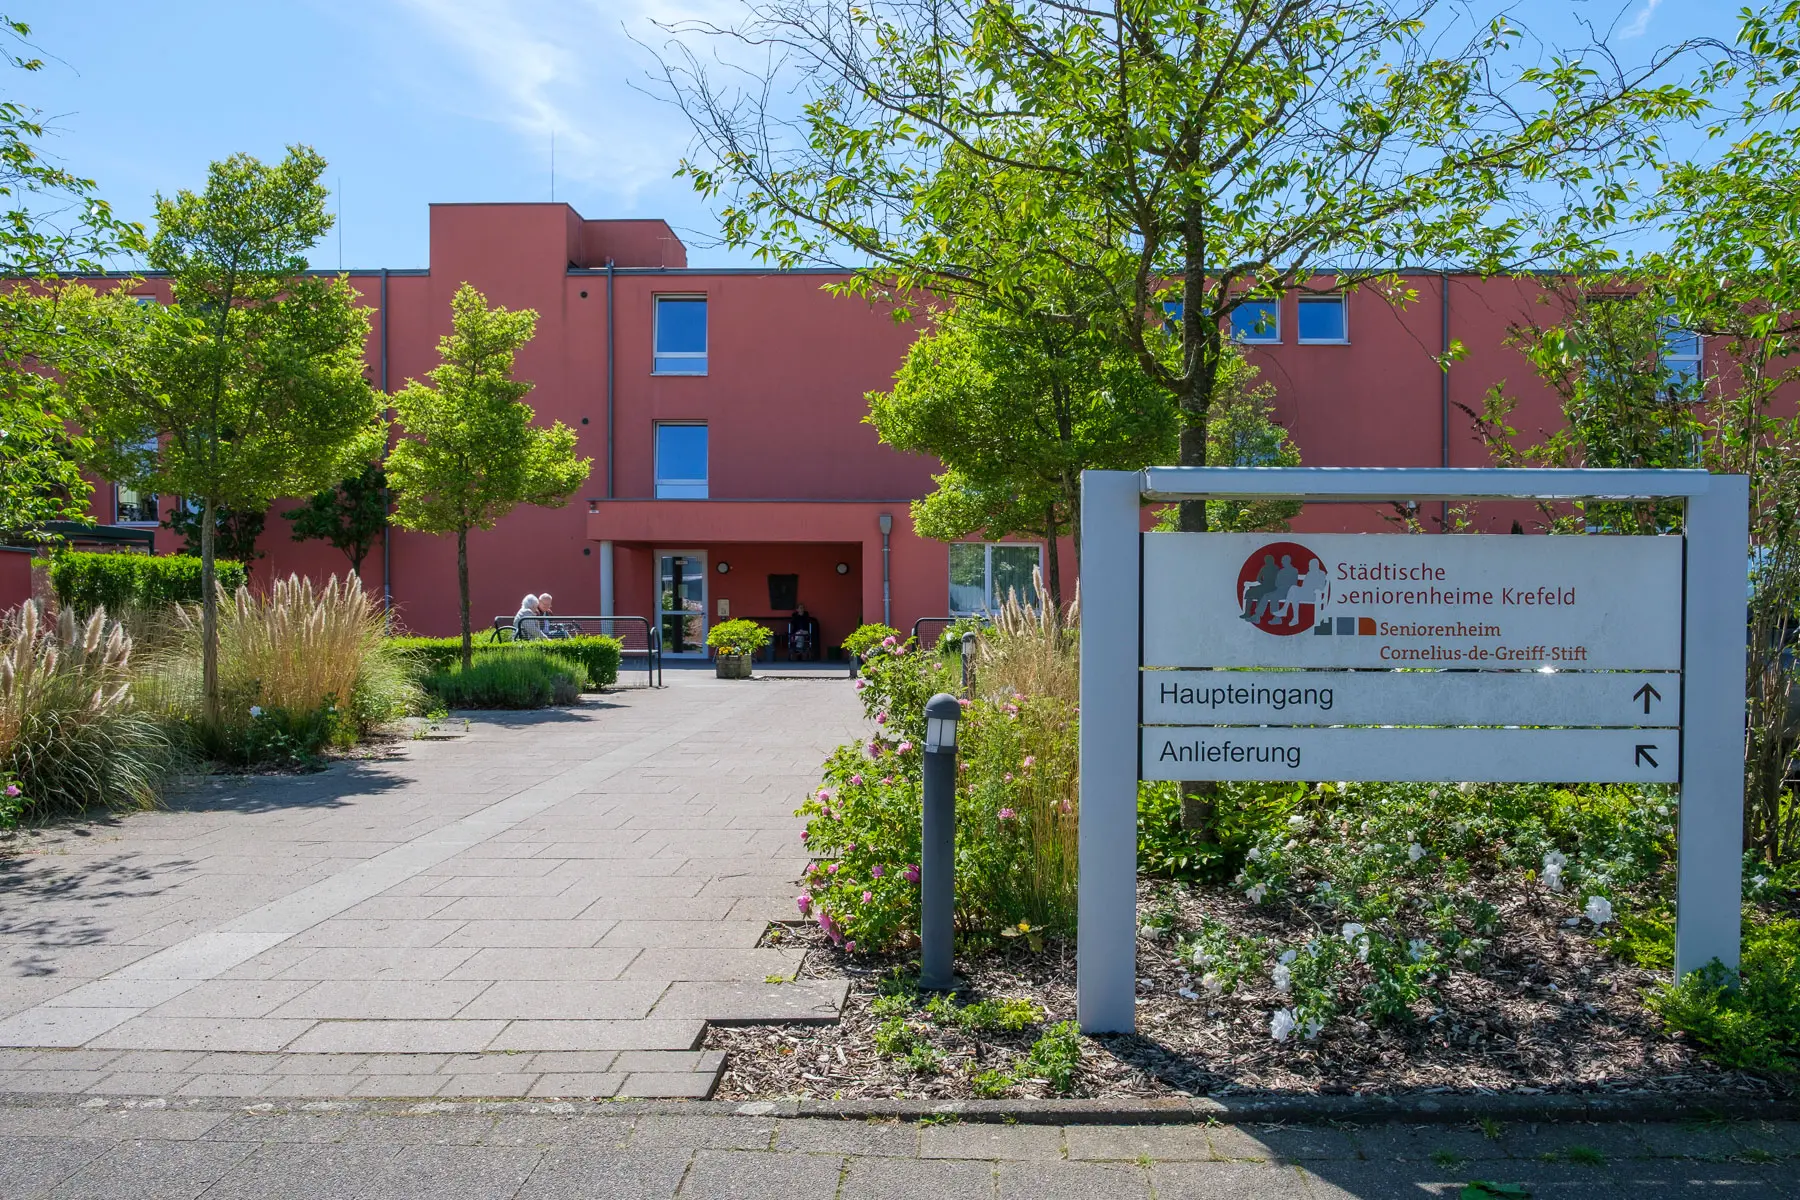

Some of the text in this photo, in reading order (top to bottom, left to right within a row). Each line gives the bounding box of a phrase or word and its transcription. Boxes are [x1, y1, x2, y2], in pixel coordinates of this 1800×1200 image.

[1337, 562, 1446, 580] Städtische
[1502, 587, 1576, 605] Krefeld
[1380, 622, 1502, 636] Seniorenheim
[1380, 645, 1587, 660] Cornelius-de-Greiff-Stift
[1160, 682, 1333, 710] Haupteingang
[1160, 740, 1301, 768] Anlieferung
